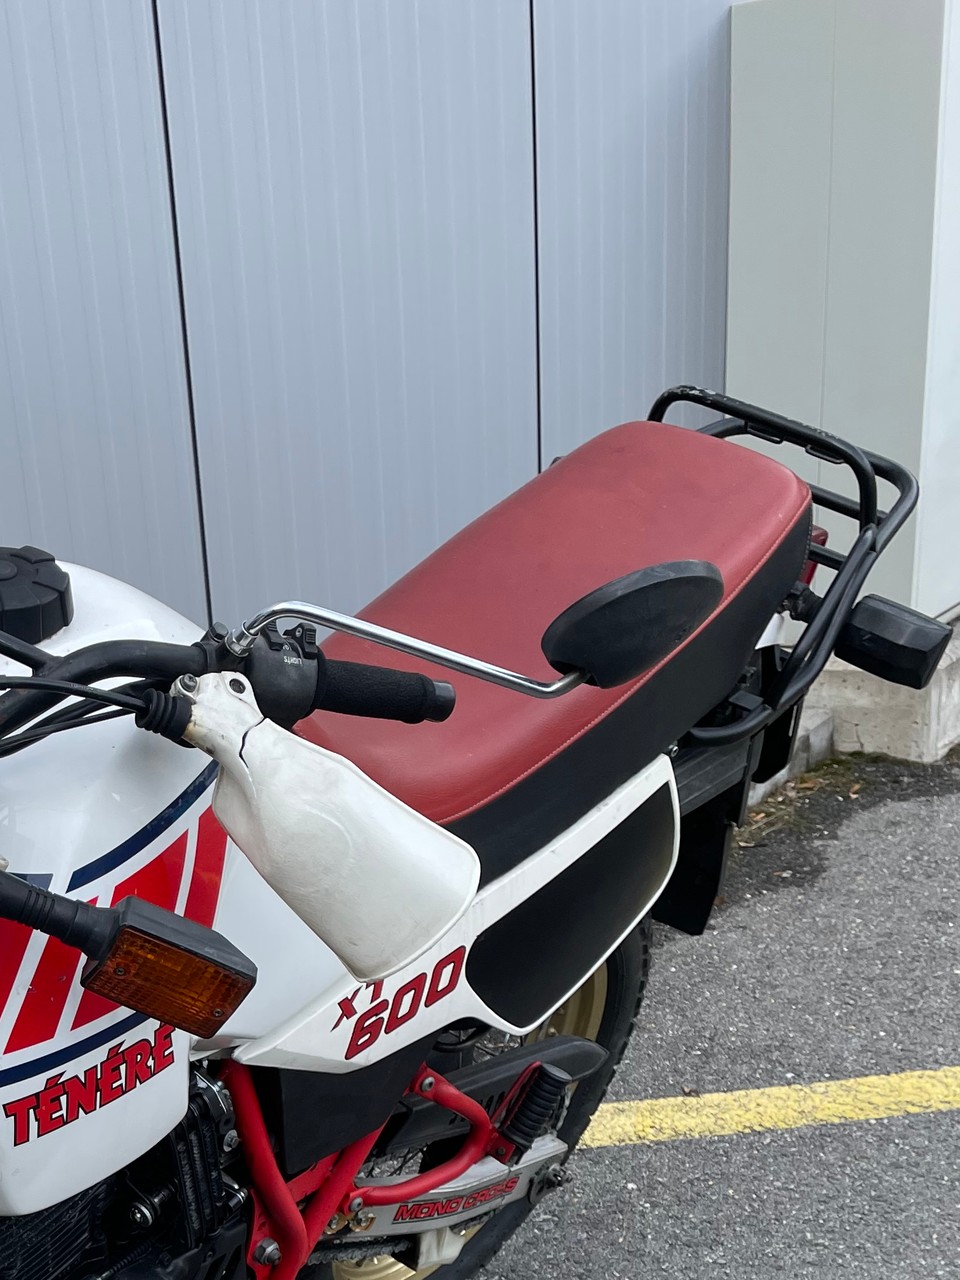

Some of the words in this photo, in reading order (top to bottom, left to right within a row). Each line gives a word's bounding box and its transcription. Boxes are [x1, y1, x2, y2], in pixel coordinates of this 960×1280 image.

[345, 945, 466, 1060] 600
[2, 1022, 176, 1147] TÉNÉRÉ
[393, 1197, 462, 1221] MONO
